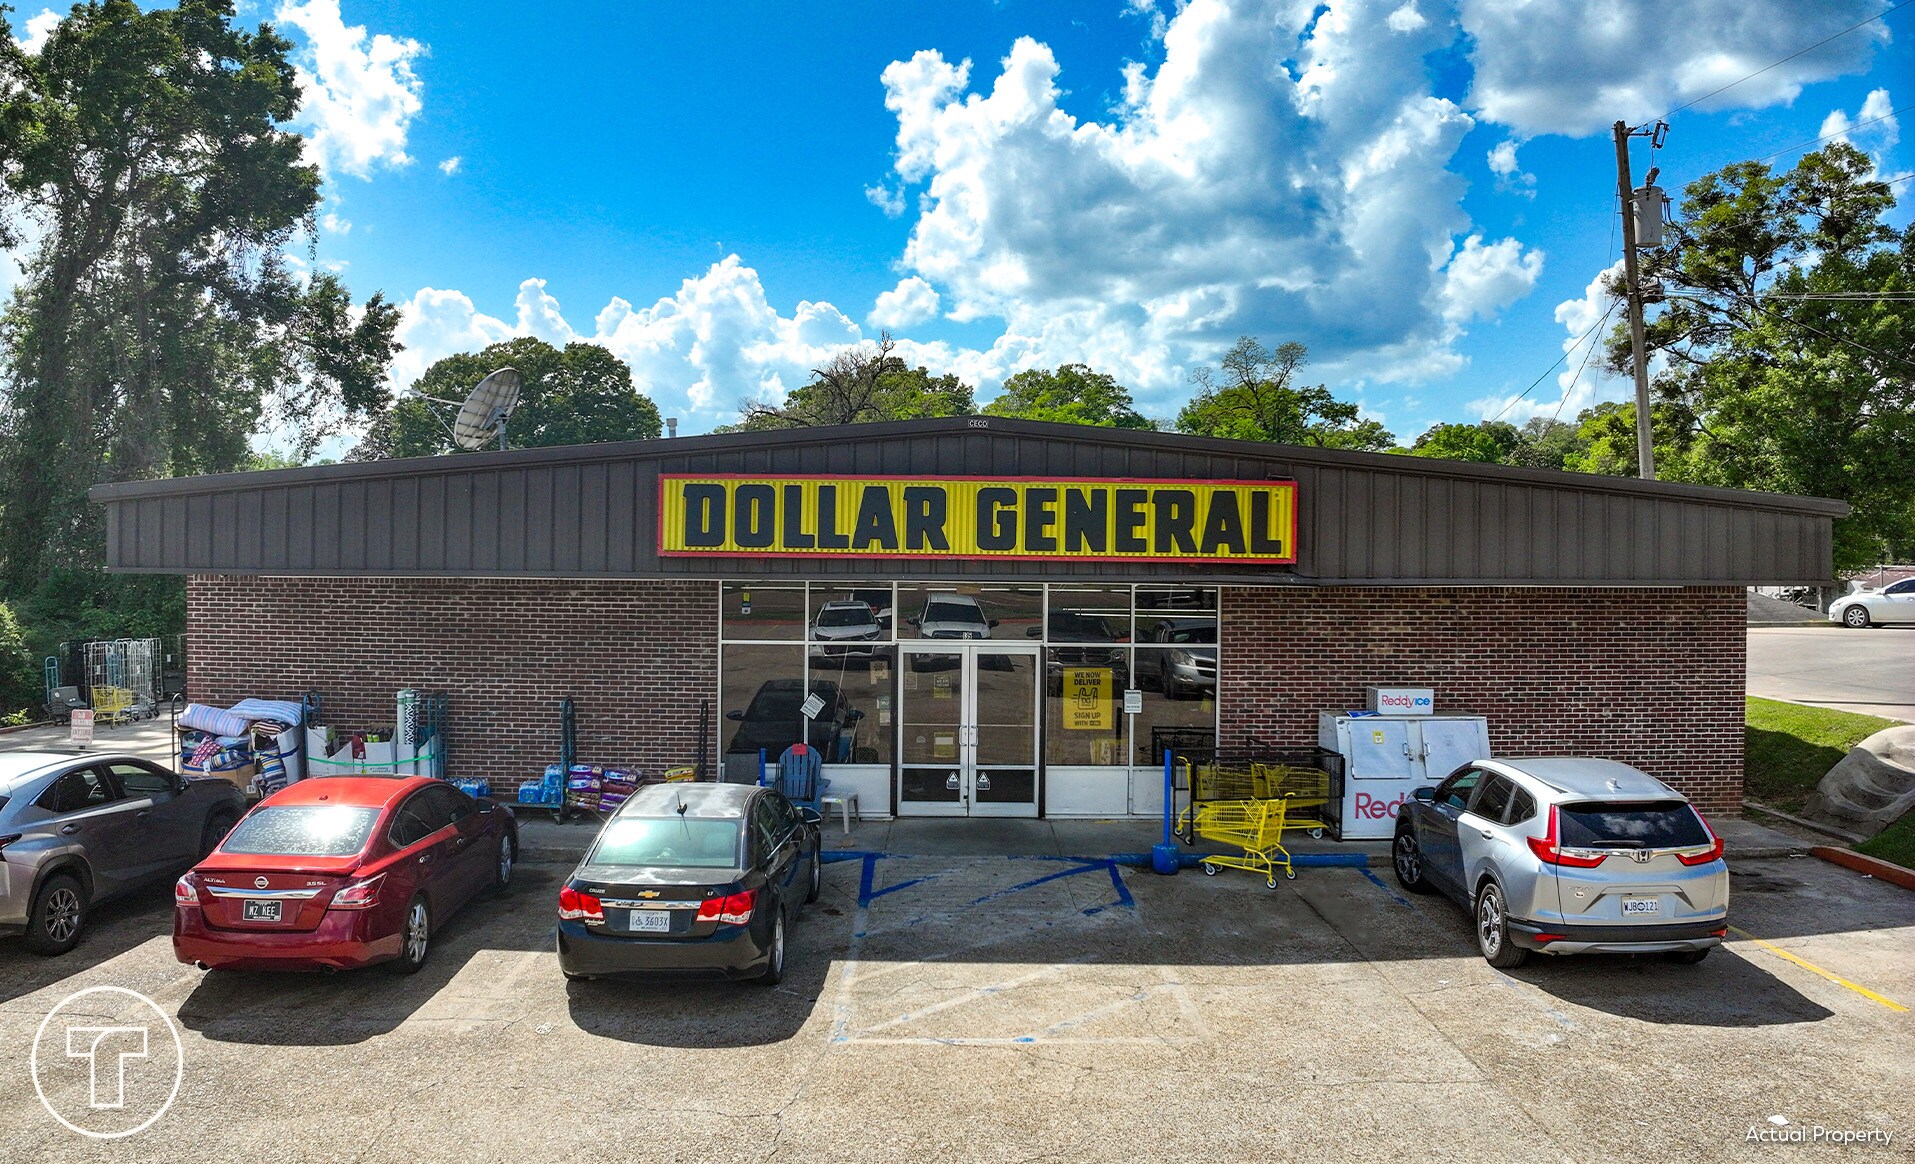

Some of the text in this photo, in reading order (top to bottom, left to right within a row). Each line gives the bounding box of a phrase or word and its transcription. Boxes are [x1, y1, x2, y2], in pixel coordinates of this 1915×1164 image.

[682, 483, 1283, 555] DOLLAR GENERAL
[1074, 712, 1101, 720] SIGN UP
